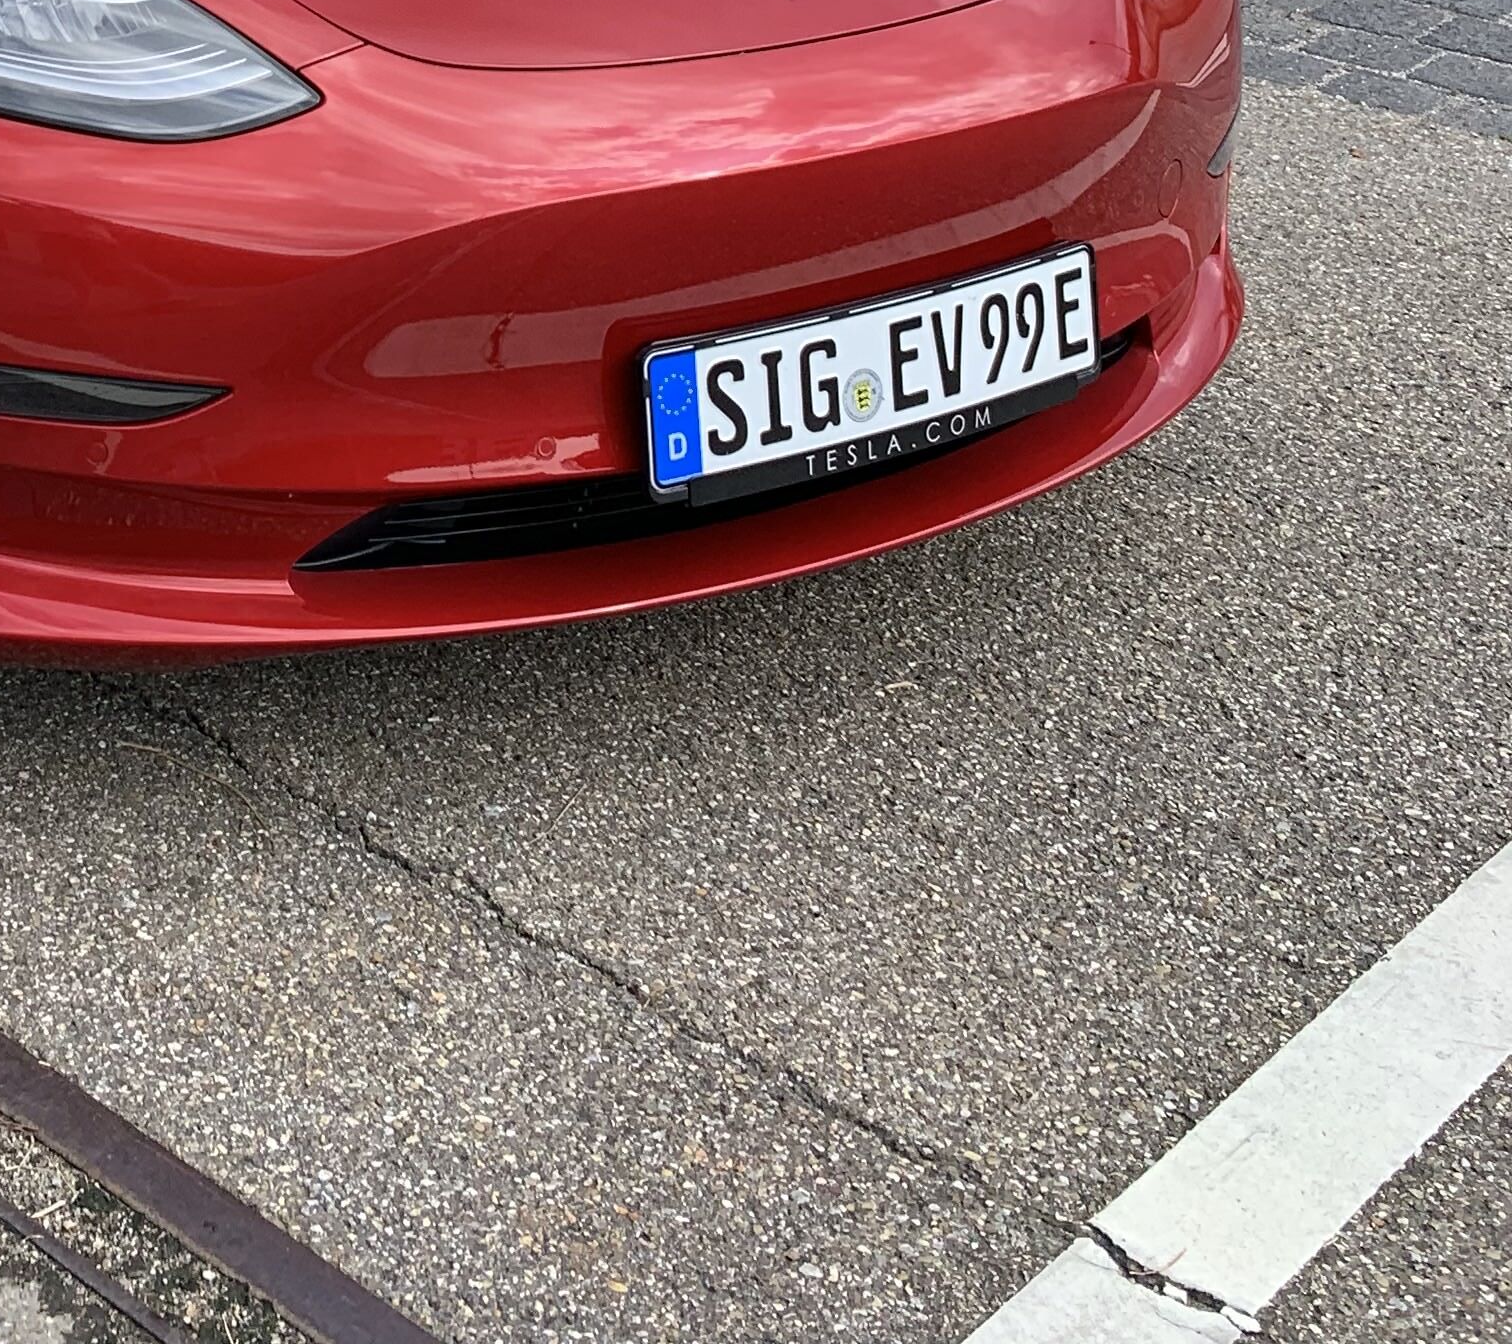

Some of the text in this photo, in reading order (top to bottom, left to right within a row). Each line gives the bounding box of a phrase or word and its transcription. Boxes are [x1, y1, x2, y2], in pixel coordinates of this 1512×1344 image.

[706, 267, 1089, 457] SIG EV99E
[668, 431, 688, 462] D
[805, 406, 994, 476] TESLA.COM
